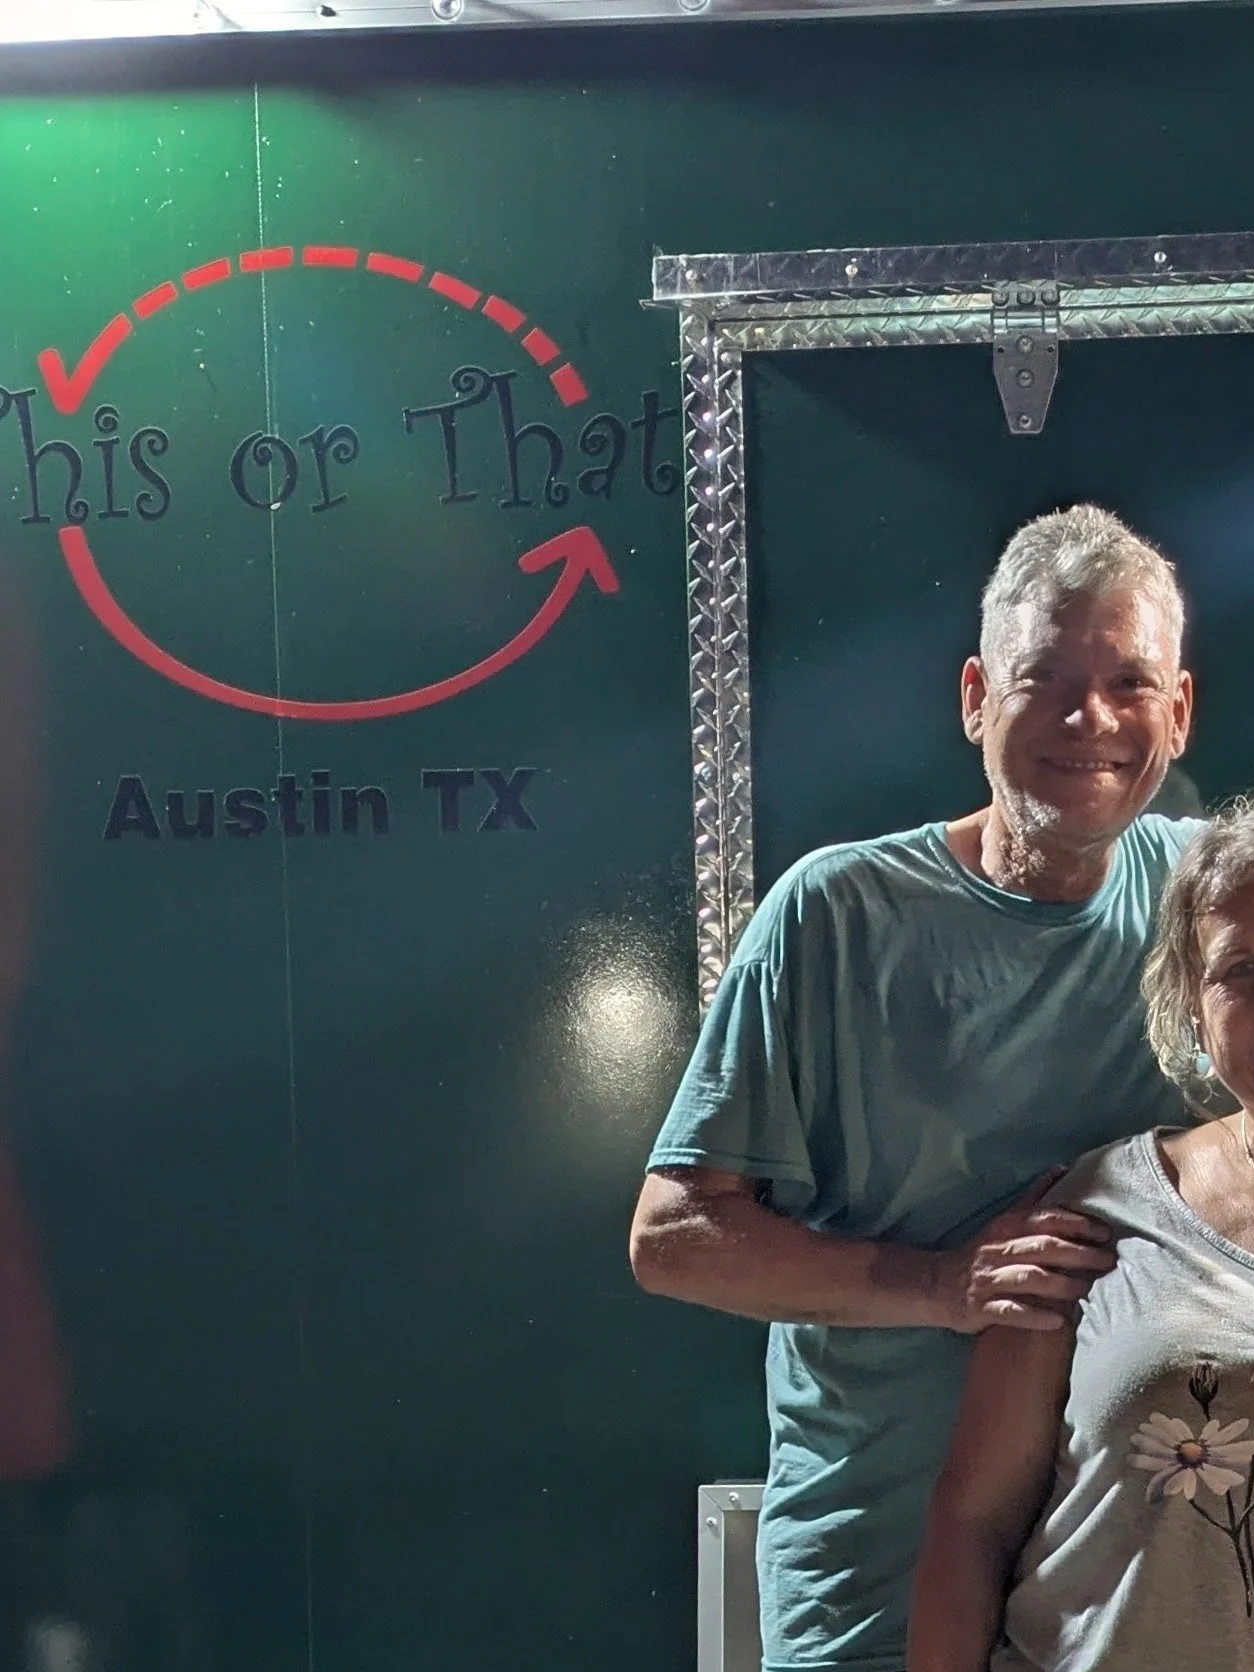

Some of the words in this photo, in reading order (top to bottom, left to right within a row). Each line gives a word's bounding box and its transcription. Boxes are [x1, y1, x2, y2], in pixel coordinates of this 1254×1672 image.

[230, 424, 360, 512] or
[403, 366, 682, 510] That
[103, 769, 390, 840] Austin
[422, 768, 541, 834] TX
